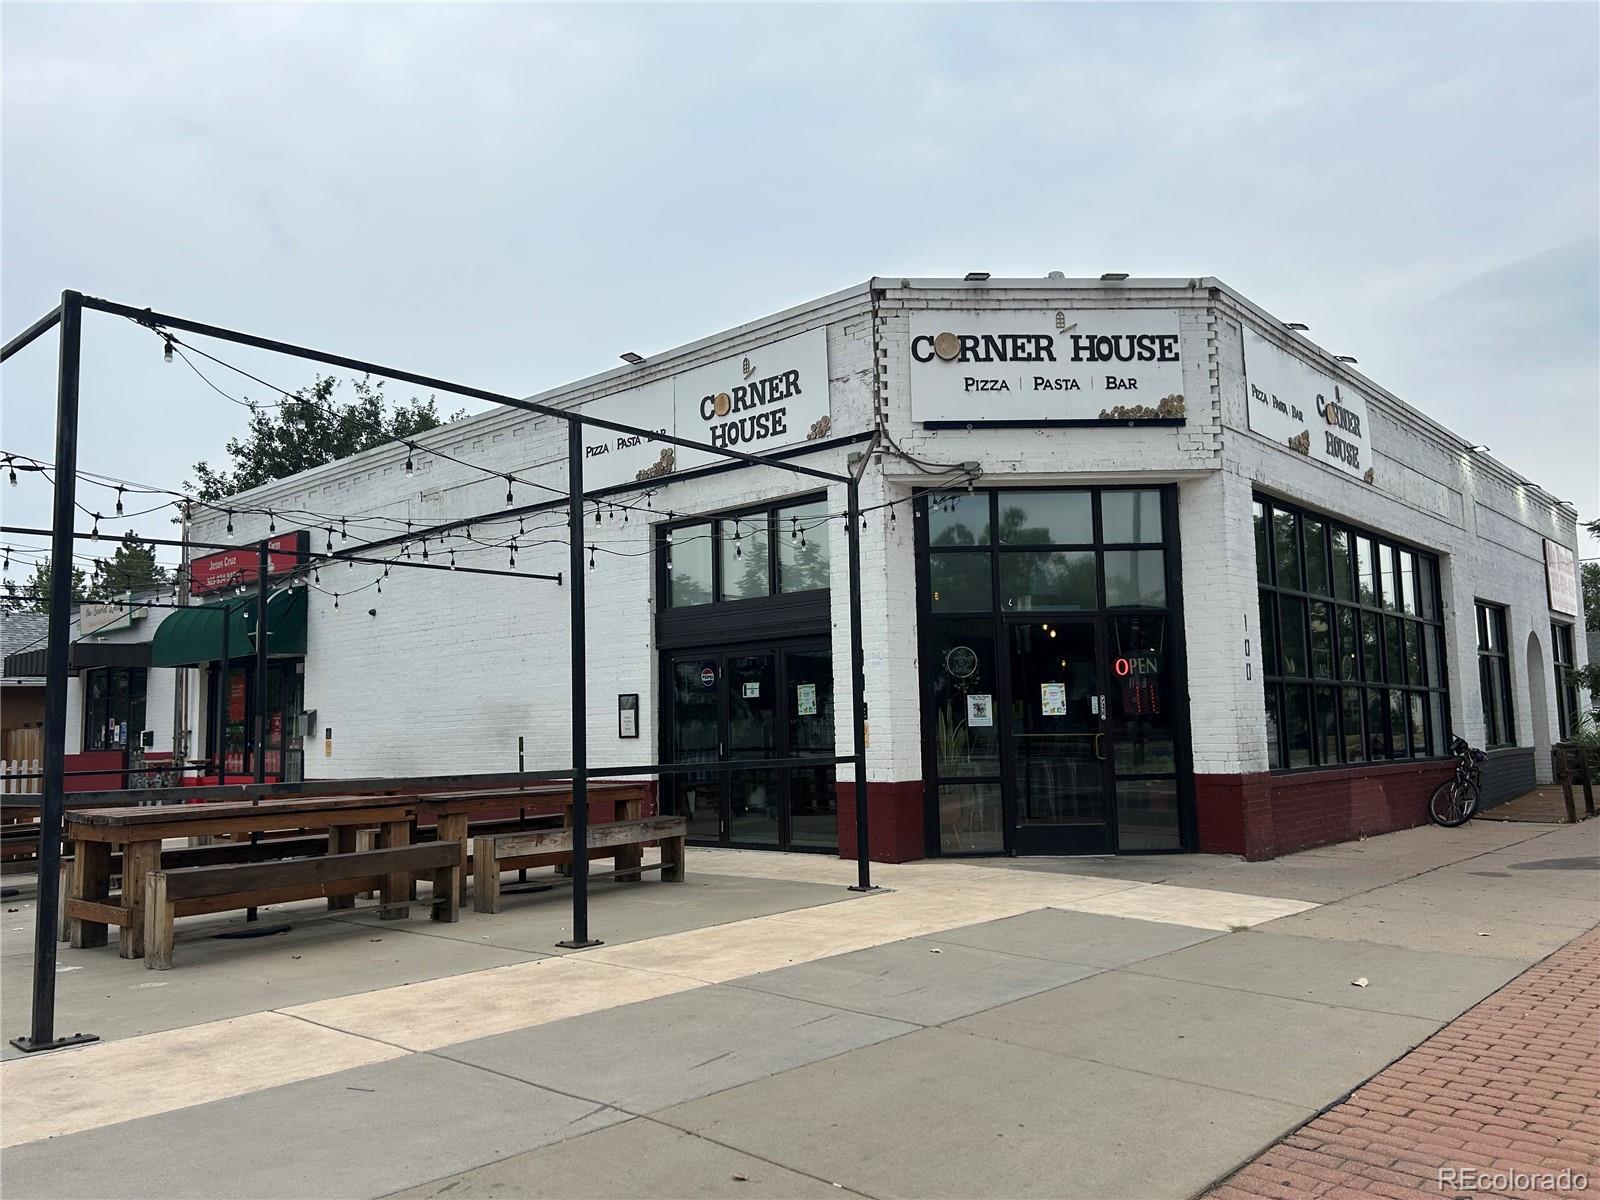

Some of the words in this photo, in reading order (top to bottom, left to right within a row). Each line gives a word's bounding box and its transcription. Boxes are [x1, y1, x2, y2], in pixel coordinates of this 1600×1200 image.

[911, 332, 1056, 363] CORNER
[1070, 334, 1180, 362] HOUSE
[700, 369, 802, 421] CORNER
[964, 377, 1010, 391] PIZZA
[1033, 377, 1080, 391] PASTA
[1105, 376, 1138, 390] BAR
[1251, 383, 1268, 406] PIZZA
[1272, 394, 1288, 415] PASTA
[1291, 404, 1304, 422] BAR
[1316, 393, 1361, 439] CORNER
[709, 407, 787, 449] HOUSE
[586, 443, 609, 458] PIZZA
[617, 435, 641, 450] PASTA
[1325, 430, 1360, 469] HOUSE
[209, 560, 223, 571] Jesus
[224, 557, 236, 567] Cruz
[1115, 657, 1158, 675] OPEN
